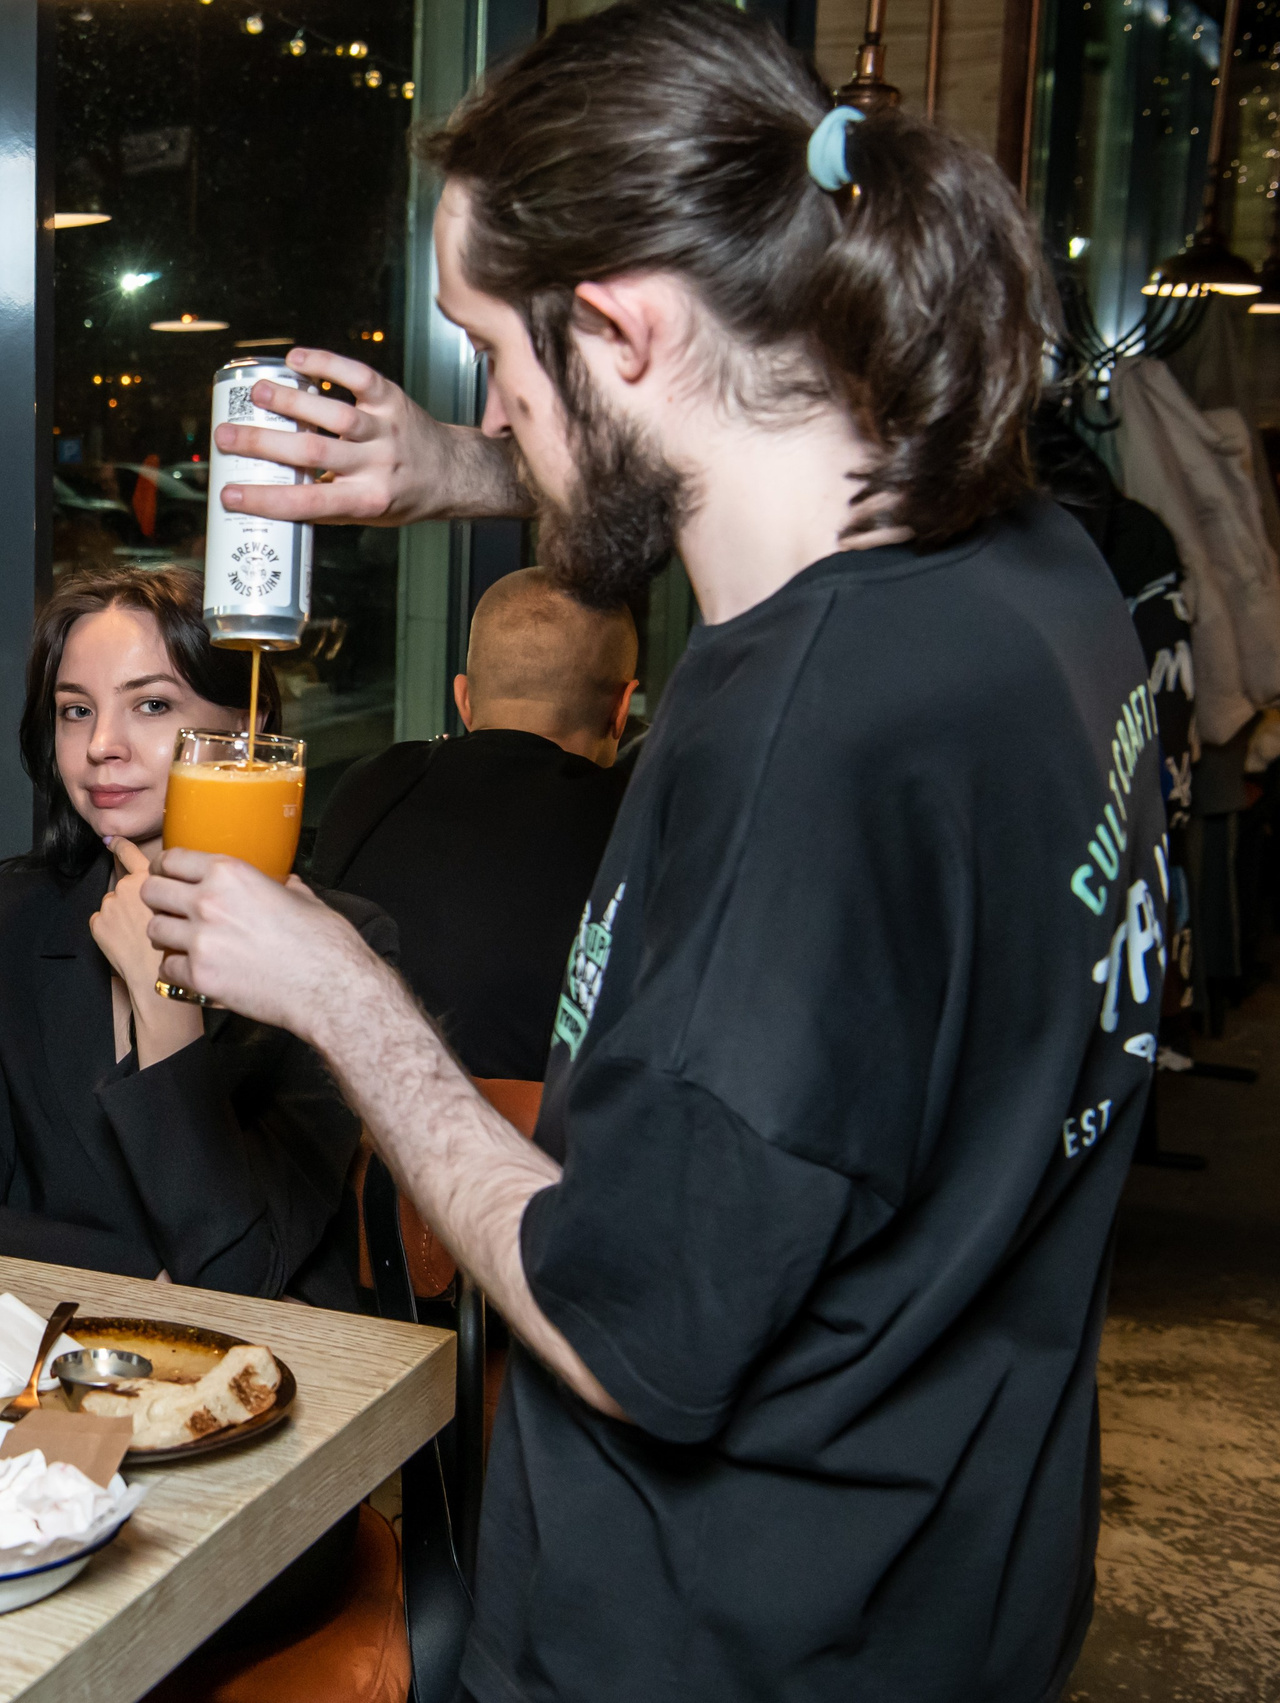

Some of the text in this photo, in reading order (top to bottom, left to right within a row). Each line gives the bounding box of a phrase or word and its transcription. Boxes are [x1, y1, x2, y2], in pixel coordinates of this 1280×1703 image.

[231, 541, 279, 563] BREWERY
[227, 570, 253, 598] STONE
[257, 570, 282, 597] WHITE
[1062, 1098, 1113, 1159] EST
